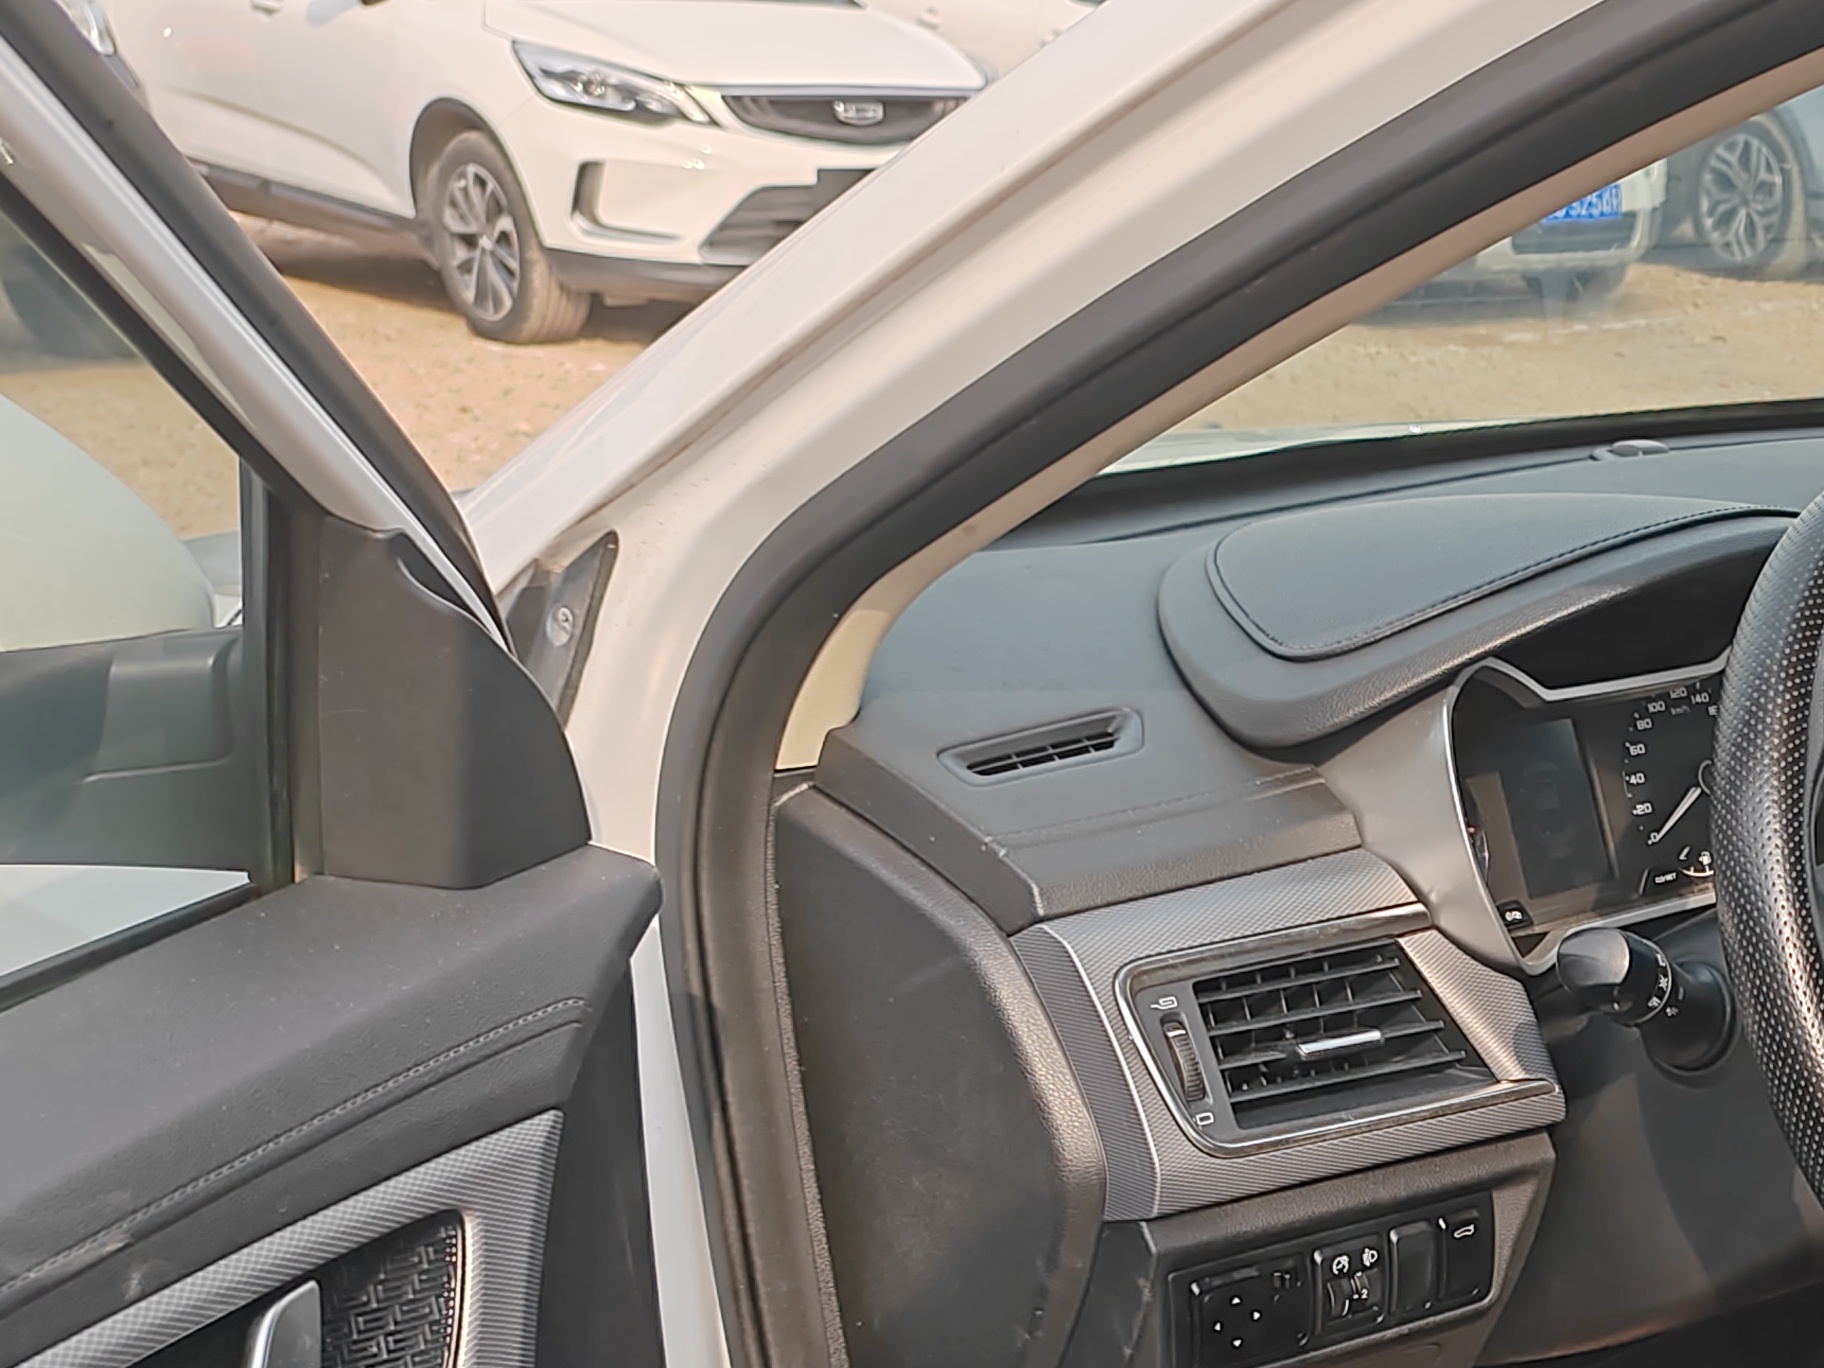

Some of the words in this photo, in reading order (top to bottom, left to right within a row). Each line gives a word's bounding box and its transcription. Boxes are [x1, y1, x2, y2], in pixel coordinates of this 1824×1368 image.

[1670, 687, 1688, 699] 120
[1690, 692, 1710, 705] 140
[1647, 701, 1666, 714] 100
[1707, 705, 1718, 716] 16
[1636, 718, 1652, 731] 80
[1629, 743, 1646, 756] 60
[1629, 772, 1646, 785] 40
[1635, 802, 1653, 815] 20
[1360, 1288, 1369, 1300] 2
